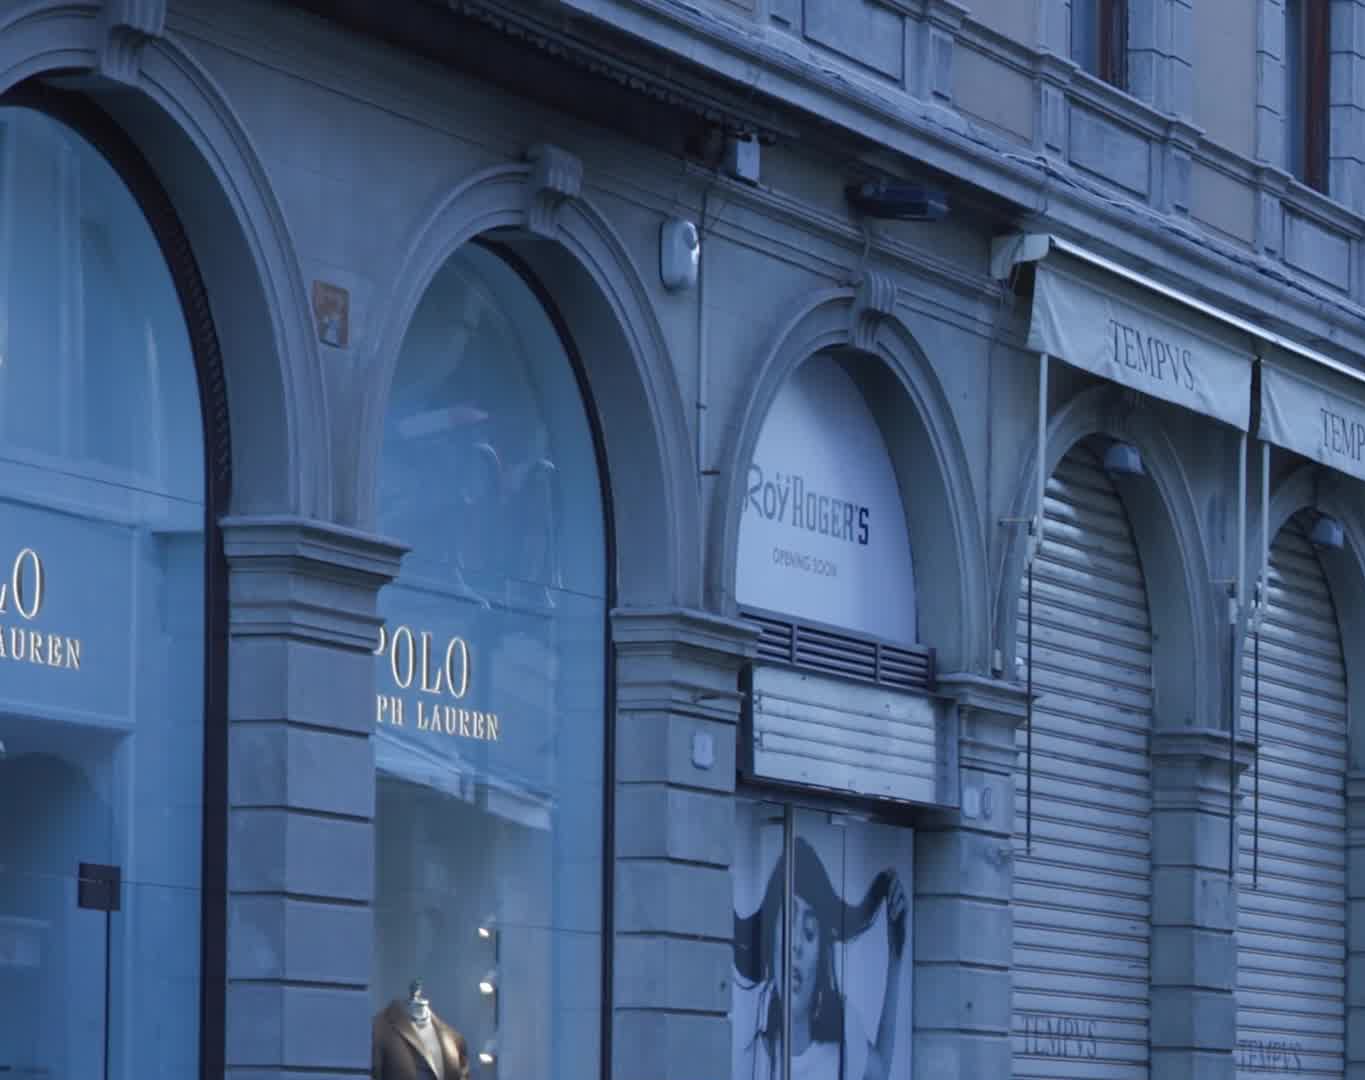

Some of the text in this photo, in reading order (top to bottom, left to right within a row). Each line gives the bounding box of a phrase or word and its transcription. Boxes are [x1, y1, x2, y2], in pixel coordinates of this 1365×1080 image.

[1109, 319, 1195, 391] TEMPVS
[772, 547, 837, 577] OPENING SOON
[417, 701, 498, 741] LAUREN
